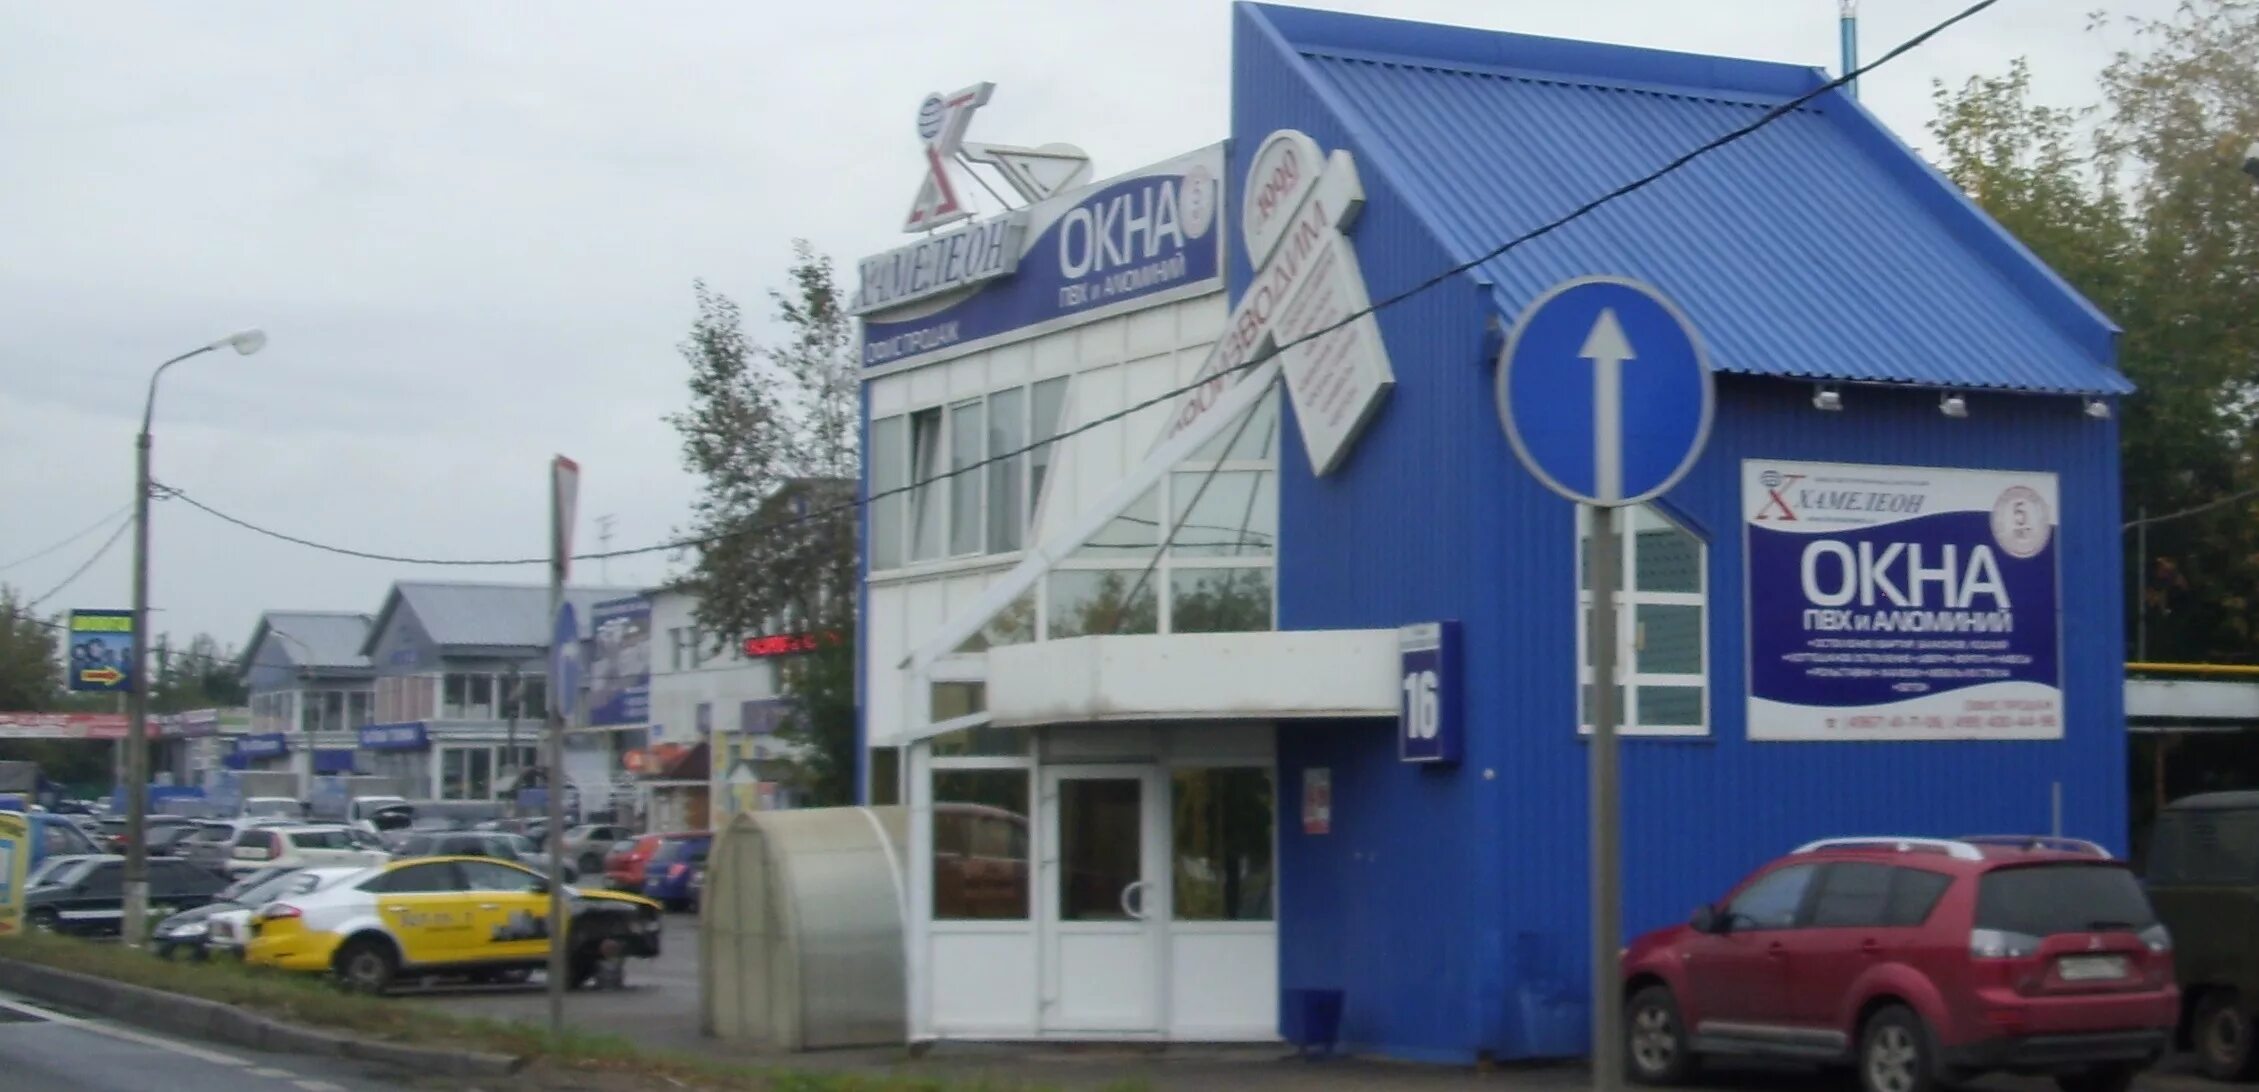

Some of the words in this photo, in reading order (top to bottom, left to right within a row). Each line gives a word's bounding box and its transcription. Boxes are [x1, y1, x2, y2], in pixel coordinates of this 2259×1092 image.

[1060, 180, 1185, 279] ОКНА
[1795, 489, 1926, 513] ХАМЕЛЕОН
[1801, 540, 2011, 608] ОКНА
[1804, 609, 1852, 630] ПВХ
[1872, 608, 2013, 632] АЛЮМИНИЙ
[1403, 670, 1438, 739] 16
